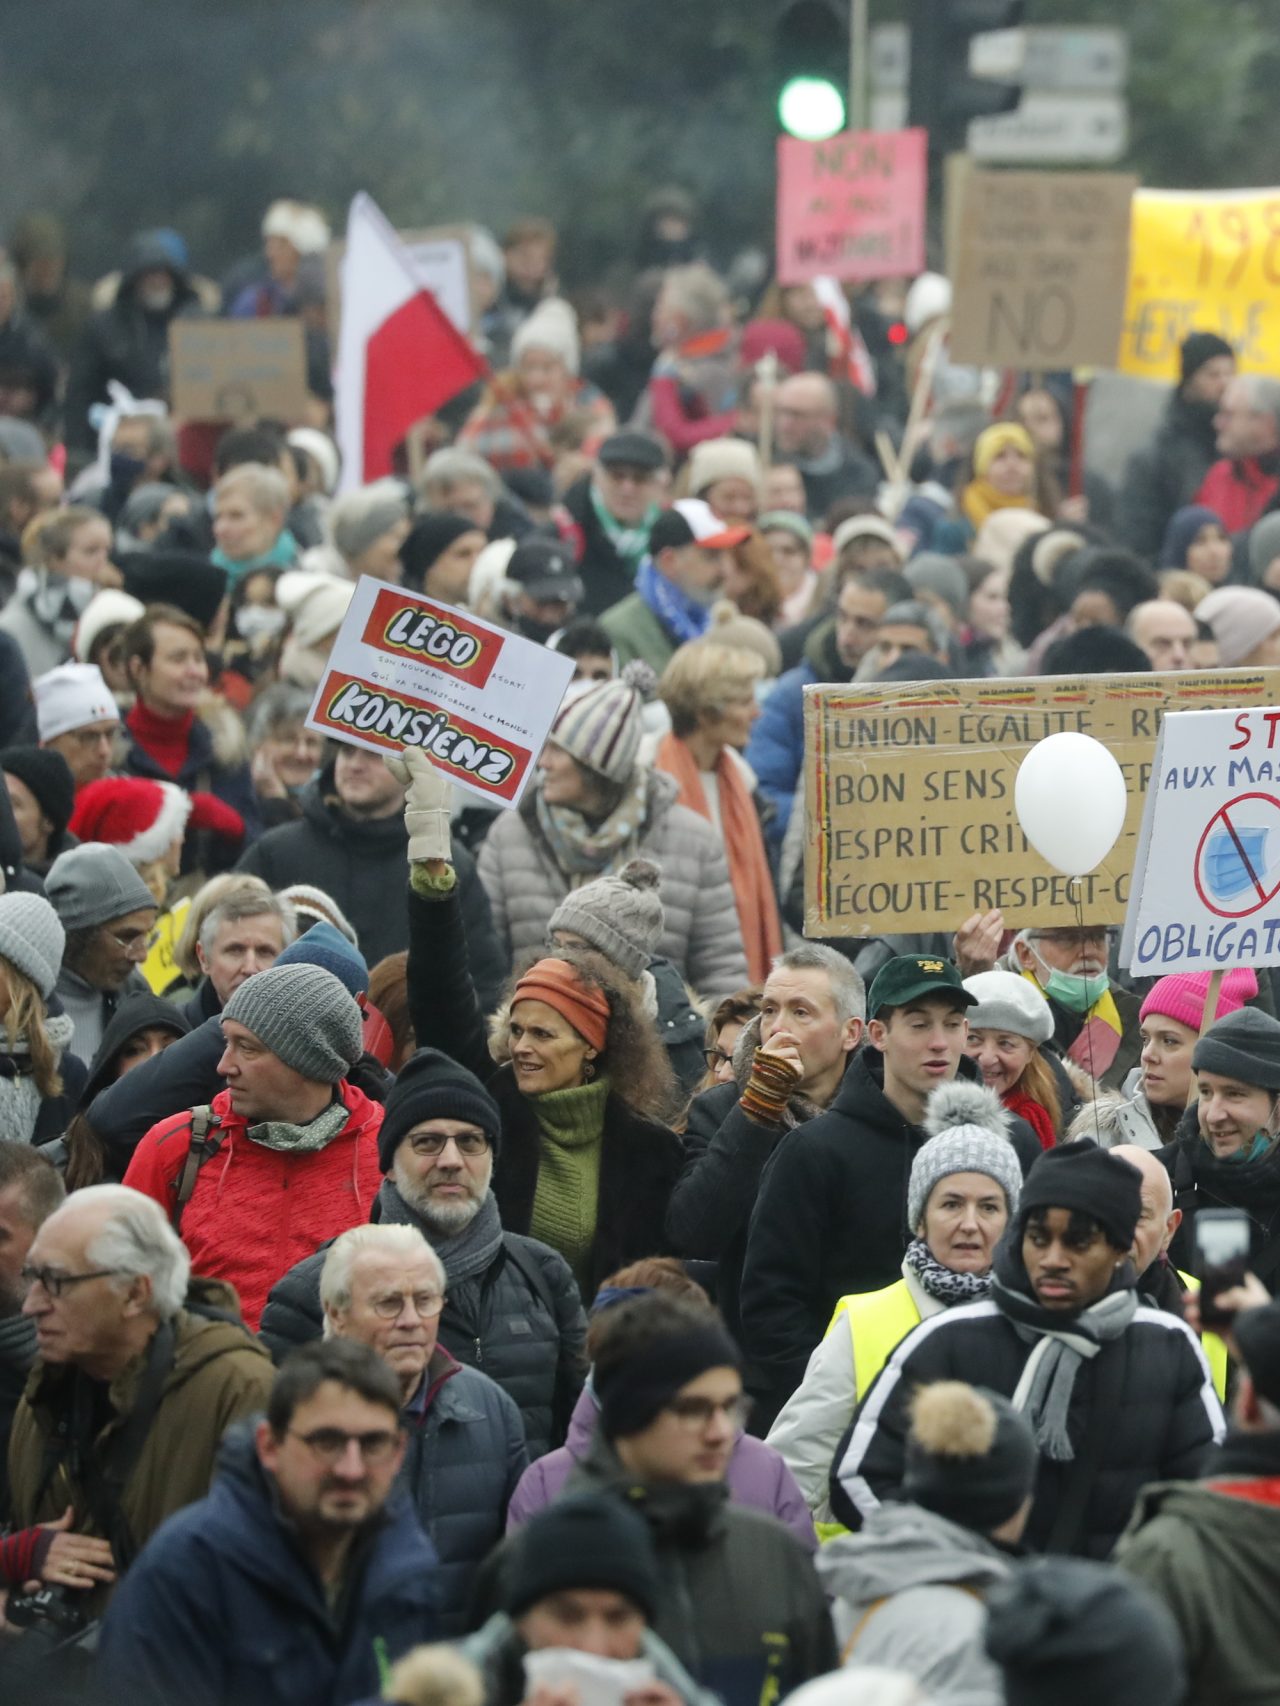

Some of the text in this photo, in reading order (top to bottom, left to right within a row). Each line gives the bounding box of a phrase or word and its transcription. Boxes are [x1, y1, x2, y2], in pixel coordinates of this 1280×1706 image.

[986, 286, 1077, 359] NO
[835, 768, 1006, 806] BON SENS
[1164, 765, 1217, 790] AUX
[835, 815, 949, 860] ESPRIT
